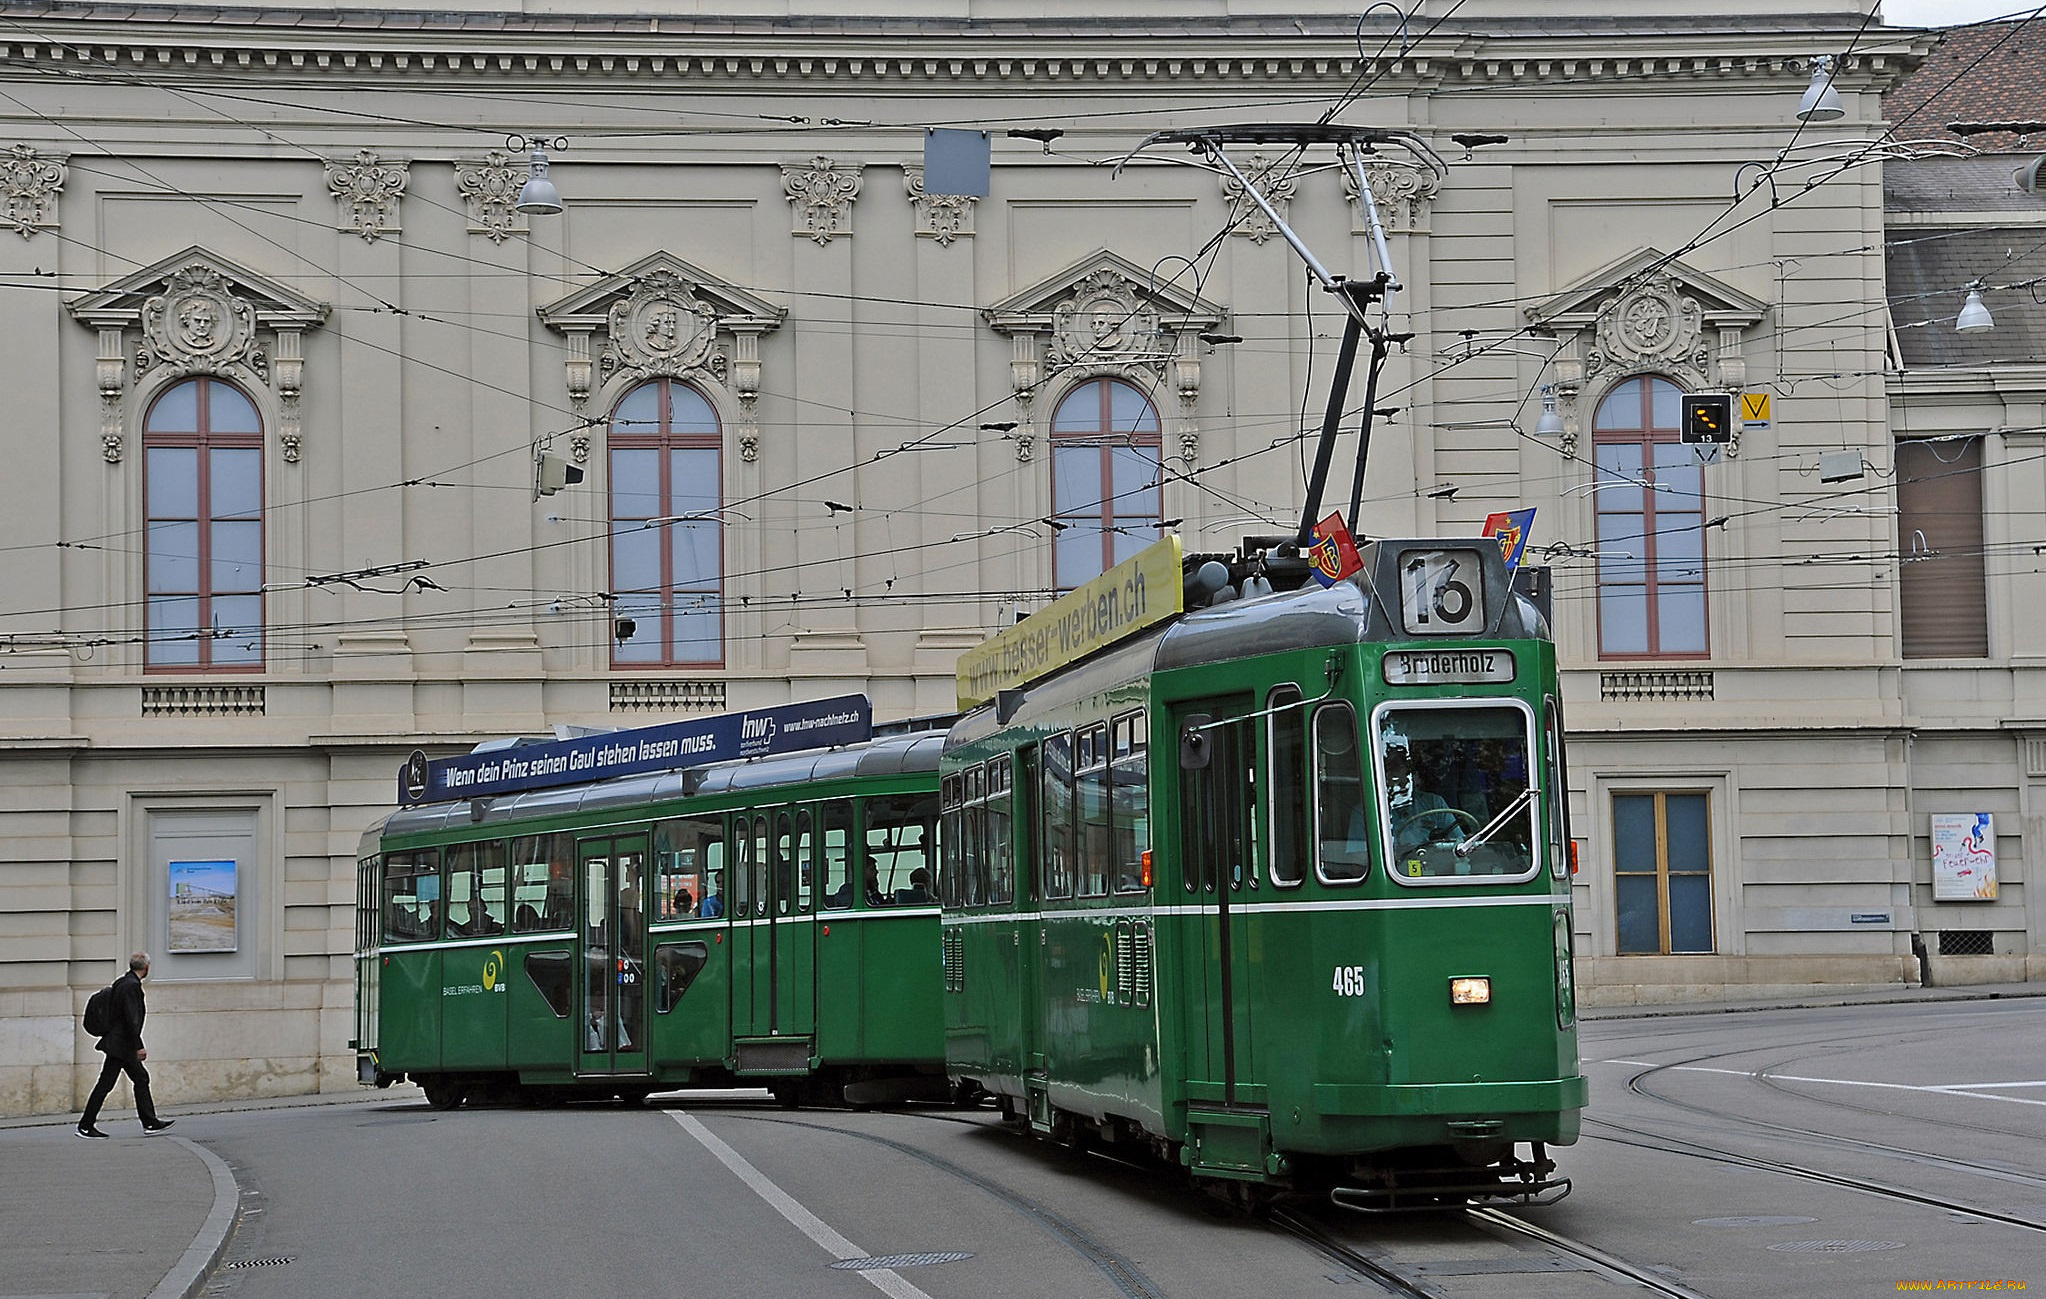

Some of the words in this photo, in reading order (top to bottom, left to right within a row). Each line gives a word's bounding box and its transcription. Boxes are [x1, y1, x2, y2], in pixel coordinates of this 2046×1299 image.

[1700, 434, 1713, 443] 13
[1406, 558, 1473, 624] 16
[969, 561, 1146, 697] www.besser-werben.ch
[1400, 653, 1495, 674] Bruderholz
[446, 766, 475, 788] Wenn
[477, 761, 500, 784] dein
[501, 757, 528, 780] Prinz
[530, 753, 567, 776] seinen
[569, 746, 596, 771] Gaul
[596, 743, 637, 767] stehen
[638, 739, 679, 761] lassen
[680, 733, 717, 755] muss.
[494, 983, 505, 992] BVB
[1332, 966, 1364, 996] 465
